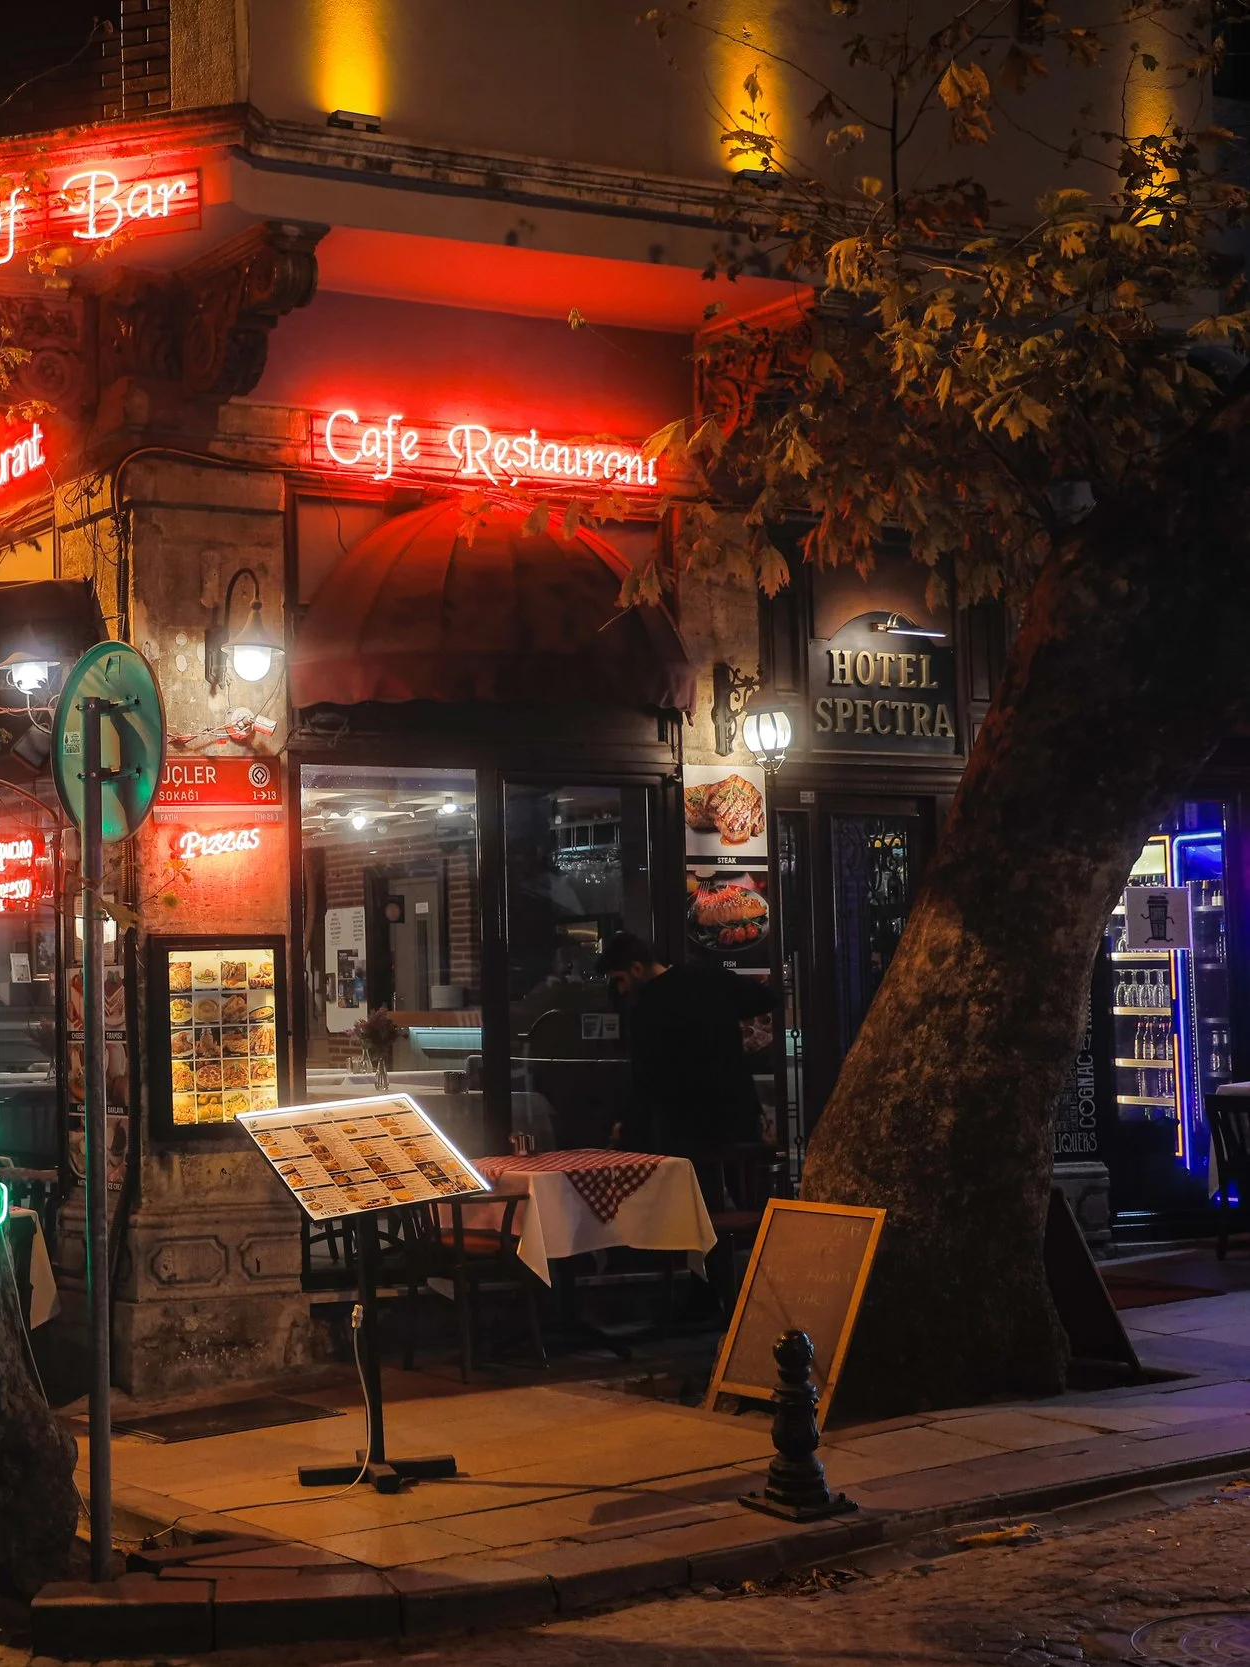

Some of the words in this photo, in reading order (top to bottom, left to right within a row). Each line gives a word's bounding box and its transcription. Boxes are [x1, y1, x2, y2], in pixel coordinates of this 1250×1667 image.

[61, 169, 187, 240] Bar
[325, 409, 420, 481] Cafe
[448, 423, 659, 488] Restaurant
[829, 649, 939, 689] HOTEL
[815, 697, 956, 738] SPECTRA
[158, 789, 199, 801] SOKAĞI
[179, 827, 261, 859] Pizzas
[723, 960, 737, 968] FISH
[1076, 1053, 1097, 1129] COGNAC
